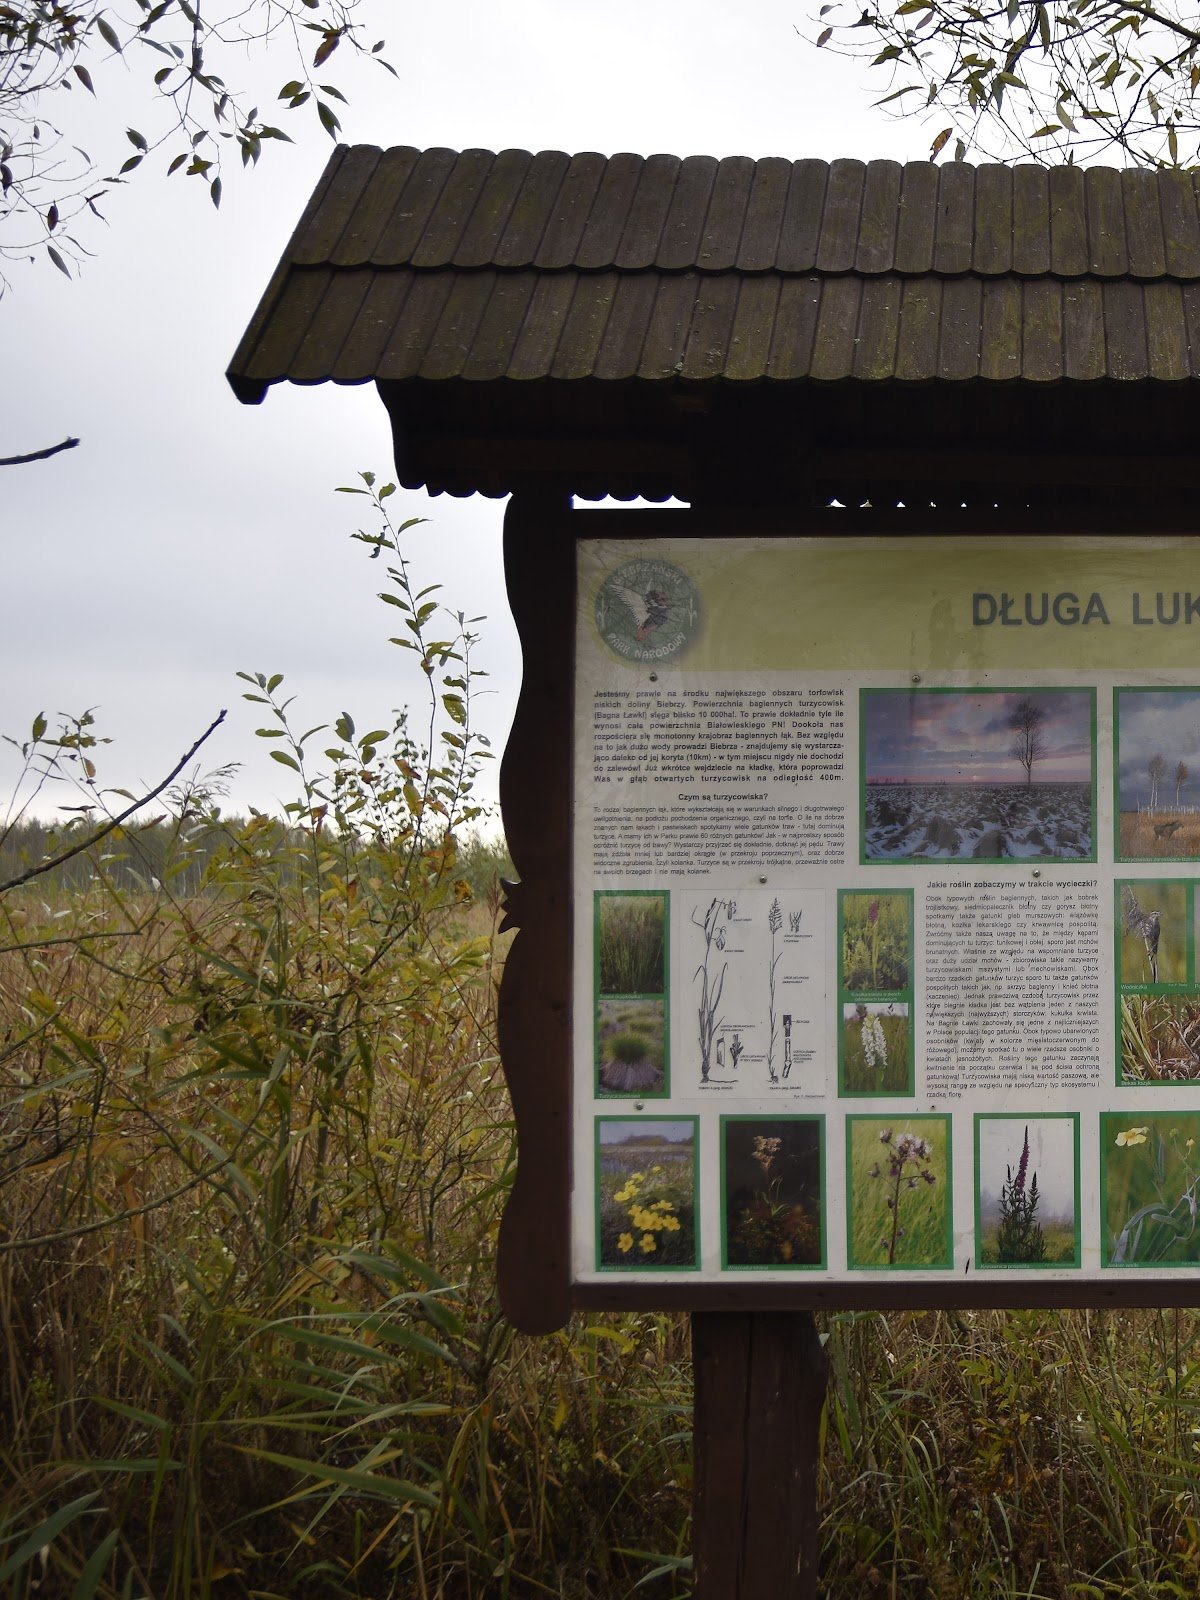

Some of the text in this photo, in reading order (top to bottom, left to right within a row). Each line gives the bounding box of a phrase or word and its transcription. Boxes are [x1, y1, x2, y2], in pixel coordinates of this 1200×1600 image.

[972, 592, 1110, 625] DŁUGA
[607, 632, 687, 659] PARK NARODOWY
[594, 690, 630, 699] Jesteśmy
[635, 690, 661, 699] prawie
[715, 689, 766, 698] największego
[593, 700, 621, 708] niskich
[627, 700, 651, 709] doliny
[748, 700, 792, 709] bagiennych
[798, 699, 844, 708] turzycowisk
[593, 711, 620, 720] (Bagna
[622, 711, 647, 720] Ławki)
[650, 711, 670, 720] sięga
[739, 710, 749, 718] To
[751, 710, 776, 719] prawie
[778, 710, 815, 718] dokładnie
[818, 710, 832, 719] tyle
[593, 722, 621, 731] wynosi
[627, 721, 643, 729] cała
[649, 721, 700, 730] powierzchnia
[707, 721, 765, 730] Białowieskiego
[594, 732, 637, 741] rozpościera
[639, 732, 650, 741] się
[653, 732, 696, 741] monotonny
[697, 732, 733, 741] krajobraz
[733, 732, 778, 741] bagiennych
[795, 731, 811, 739] Bez
[812, 731, 844, 740] względu
[615, 743, 627, 752] jak
[650, 743, 671, 752] wody
[673, 742, 707, 752] prowadzi
[709, 742, 738, 750] Biebrza
[745, 742, 788, 751] znajdujemy
[790, 742, 801, 751] się
[593, 754, 609, 763] jąco
[611, 753, 636, 761] daleko
[638, 753, 647, 761] od
[649, 753, 658, 762] jej
[660, 753, 684, 762] koryta
[686, 753, 711, 762] (10km)
[726, 753, 740, 762] tym
[742, 753, 771, 762] miejscu
[773, 753, 794, 762] nigdy
[796, 752, 807, 760] nie
[810, 752, 843, 760] dochodzi
[593, 764, 603, 772] do
[694, 764, 732, 773] wejdziecie
[778, 763, 797, 771] która
[801, 763, 843, 772] poprowadzi
[629, 775, 647, 784] głąb
[653, 774, 695, 784] otwartych
[700, 774, 750, 783] turzycowisk
[772, 774, 813, 783] odległość
[678, 792, 768, 802] Czym są turzycowiska?
[926, 880, 947, 888] Jakie
[949, 880, 971, 888] roślin
[973, 880, 1017, 889] zobaczymy
[1055, 880, 1097, 889] wycieczki?
